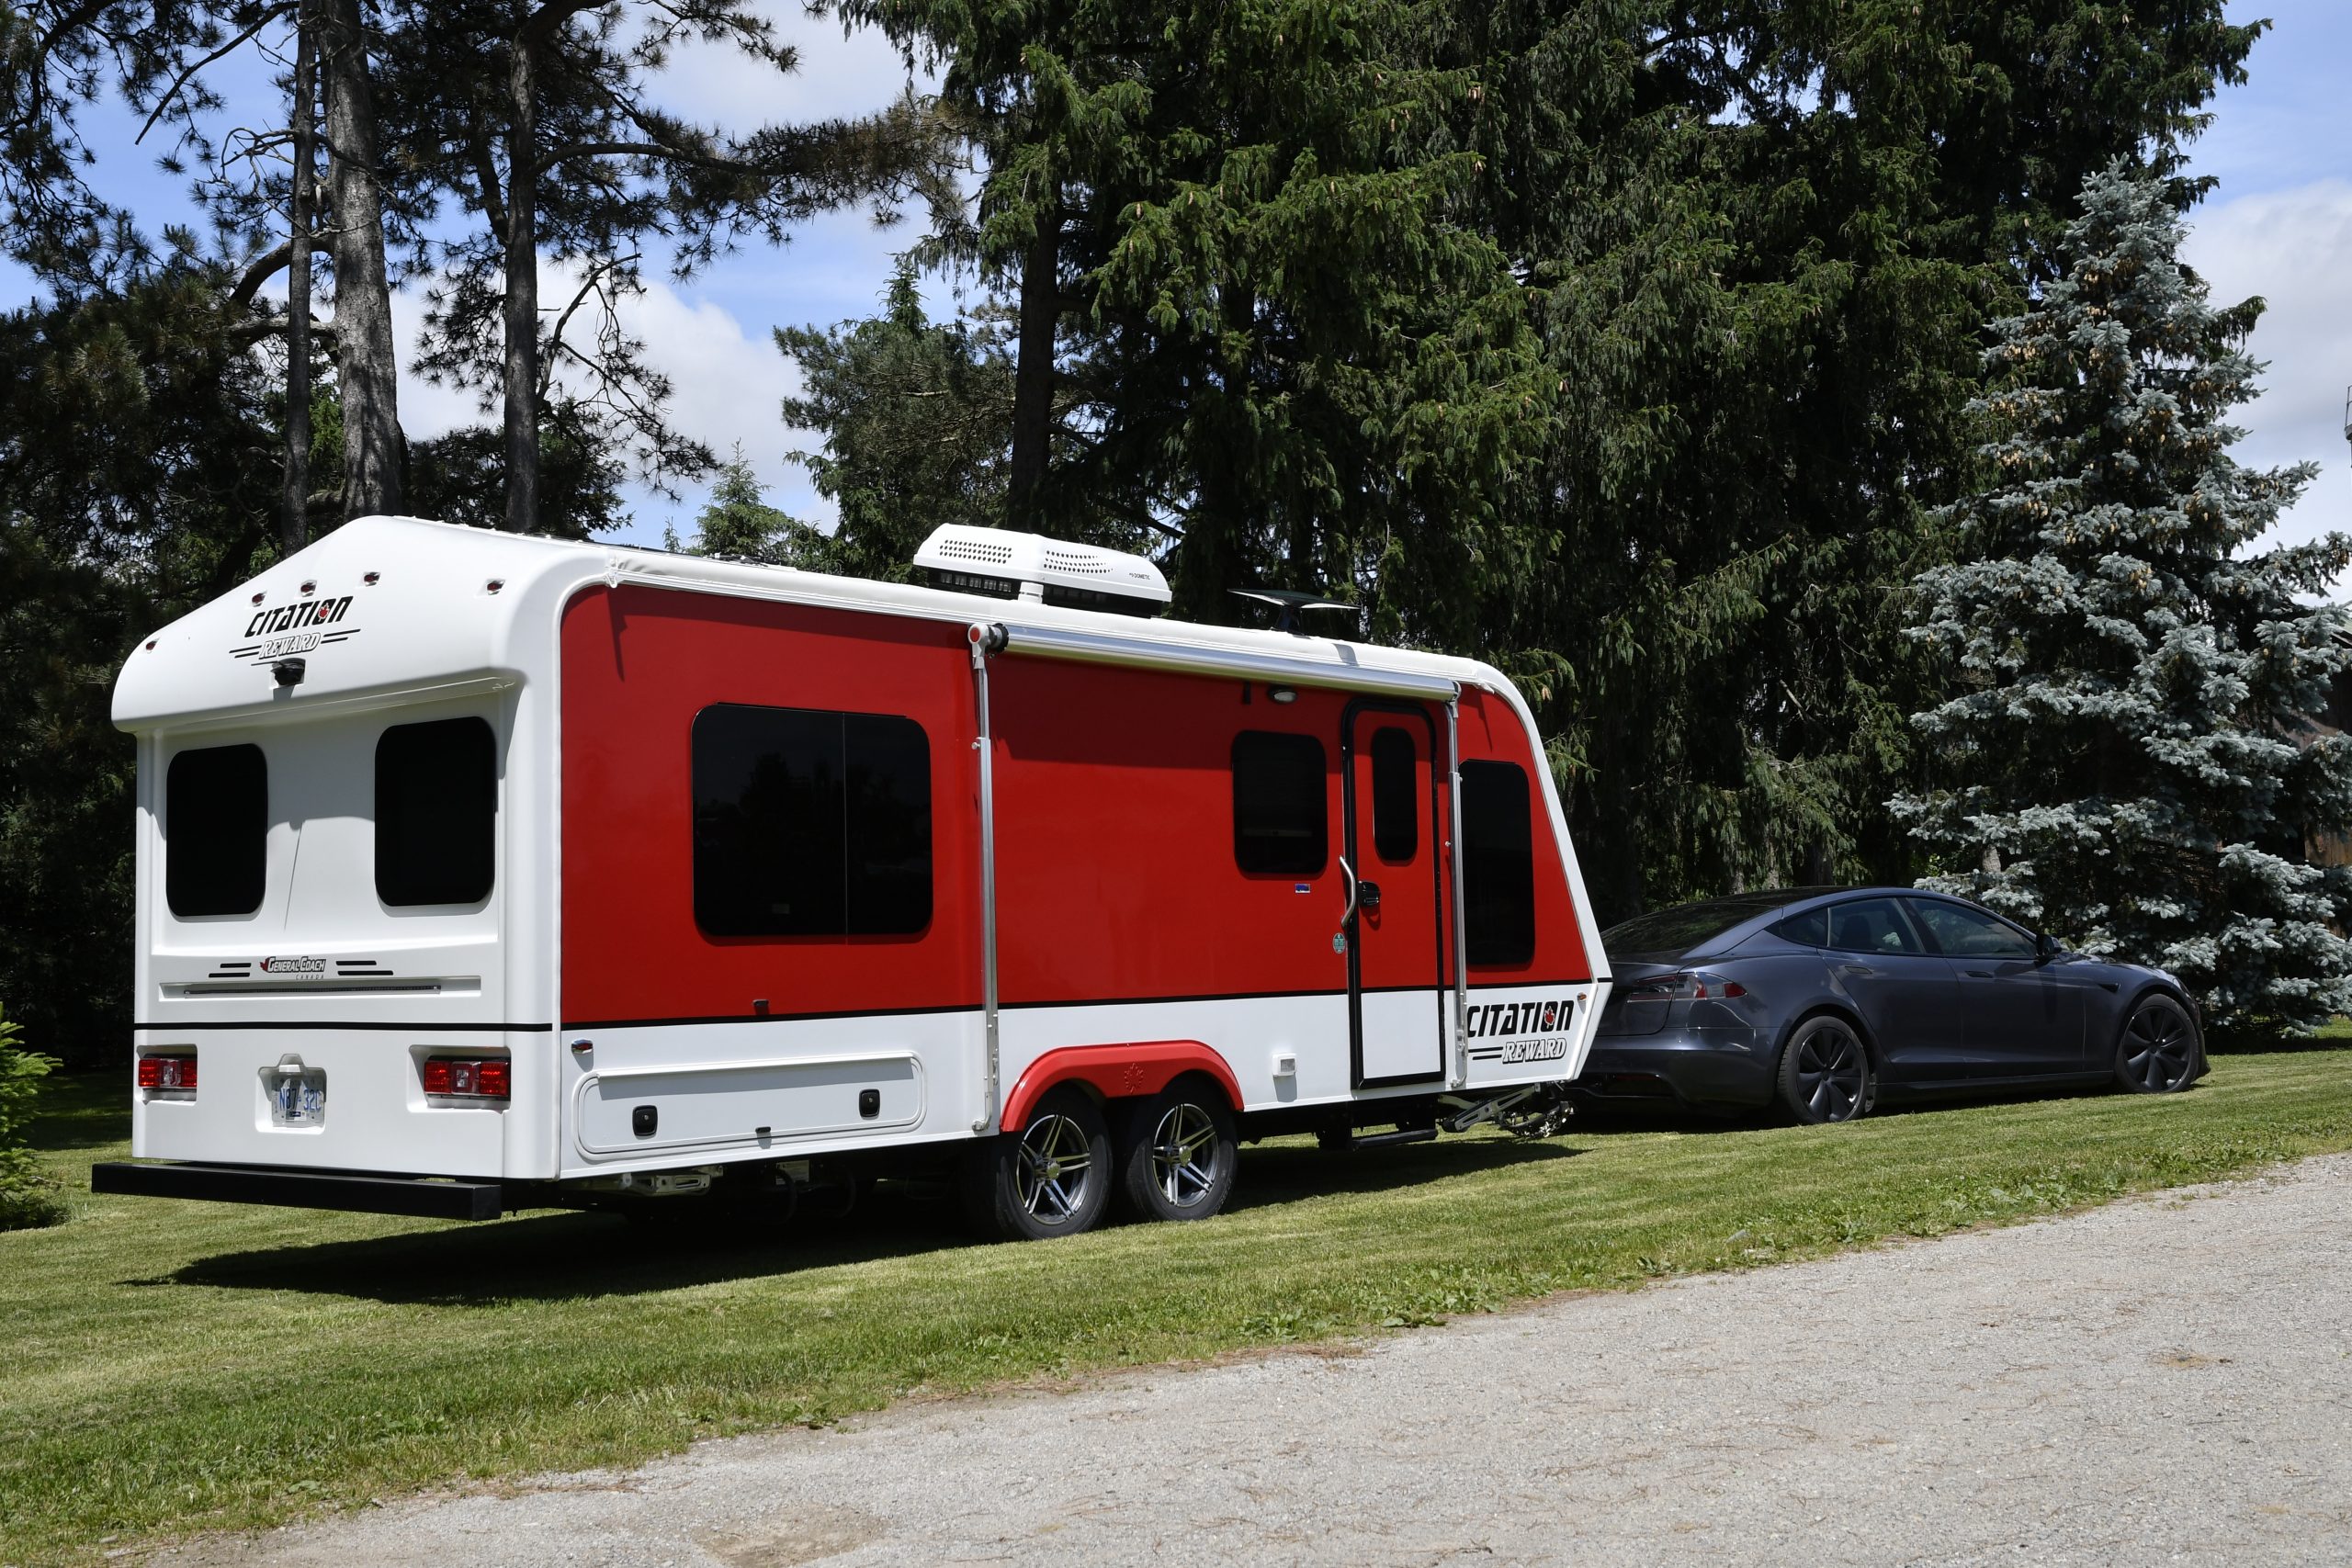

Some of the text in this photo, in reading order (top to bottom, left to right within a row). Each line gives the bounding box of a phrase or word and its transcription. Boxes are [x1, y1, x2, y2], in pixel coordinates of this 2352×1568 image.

[244, 596, 353, 637] CITATION
[258, 632, 321, 660] REWARD
[267, 956, 326, 973] GENERAL COACH
[1467, 1000, 1574, 1037] CITATION
[1502, 1038, 1566, 1064] REWARD
